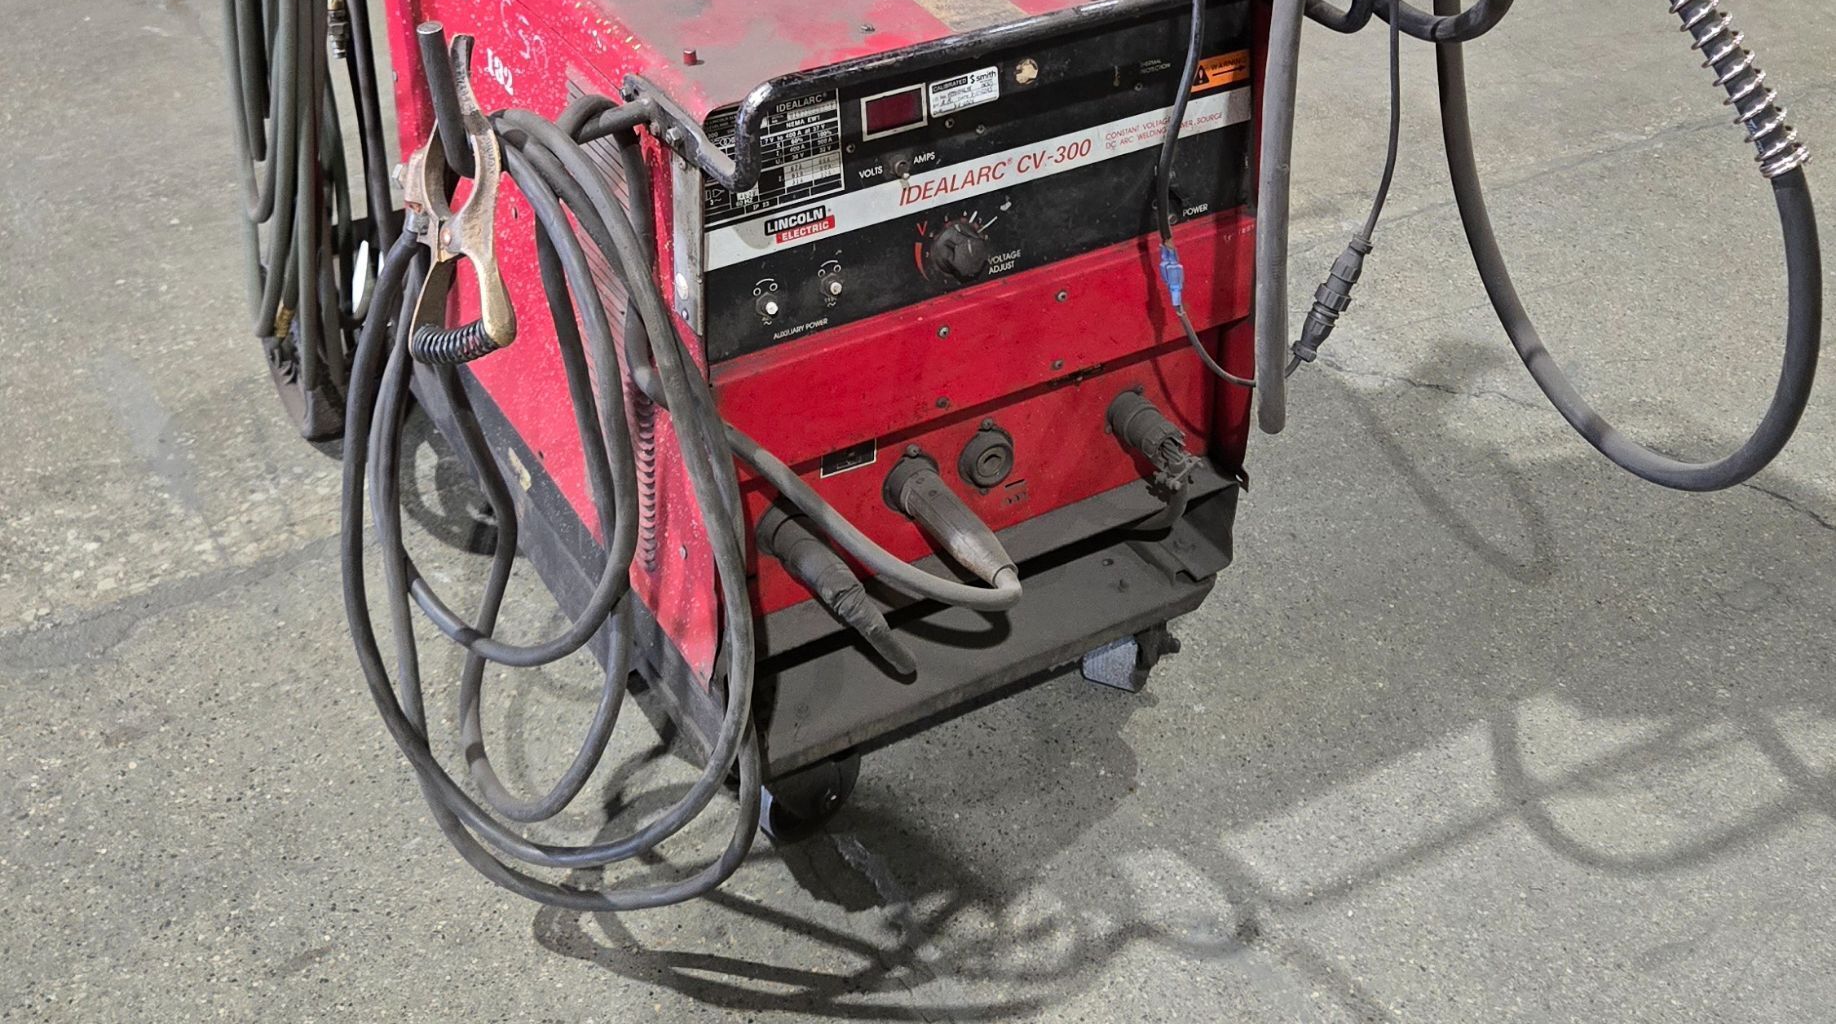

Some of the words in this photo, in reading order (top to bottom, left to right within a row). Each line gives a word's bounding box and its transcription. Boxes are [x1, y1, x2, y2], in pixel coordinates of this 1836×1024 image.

[976, 70, 997, 82] smith
[932, 77, 967, 92] CALIBRATED
[776, 95, 823, 113] IDEALARC
[786, 119, 805, 129] NEMA
[1105, 124, 1140, 141] CONSTANT
[1105, 140, 1117, 150] DC
[1119, 134, 1136, 147] ARC
[913, 151, 936, 165] AMPS
[1016, 137, 1093, 174] CV-300
[858, 165, 884, 179] VOLTS
[1182, 202, 1209, 217] POWER
[766, 207, 824, 234] LINCOLN
[780, 219, 830, 241] ELECTRIC
[988, 249, 1022, 265] VOLTAGE
[988, 260, 1016, 275] ADJUST
[805, 317, 829, 330] POWER
